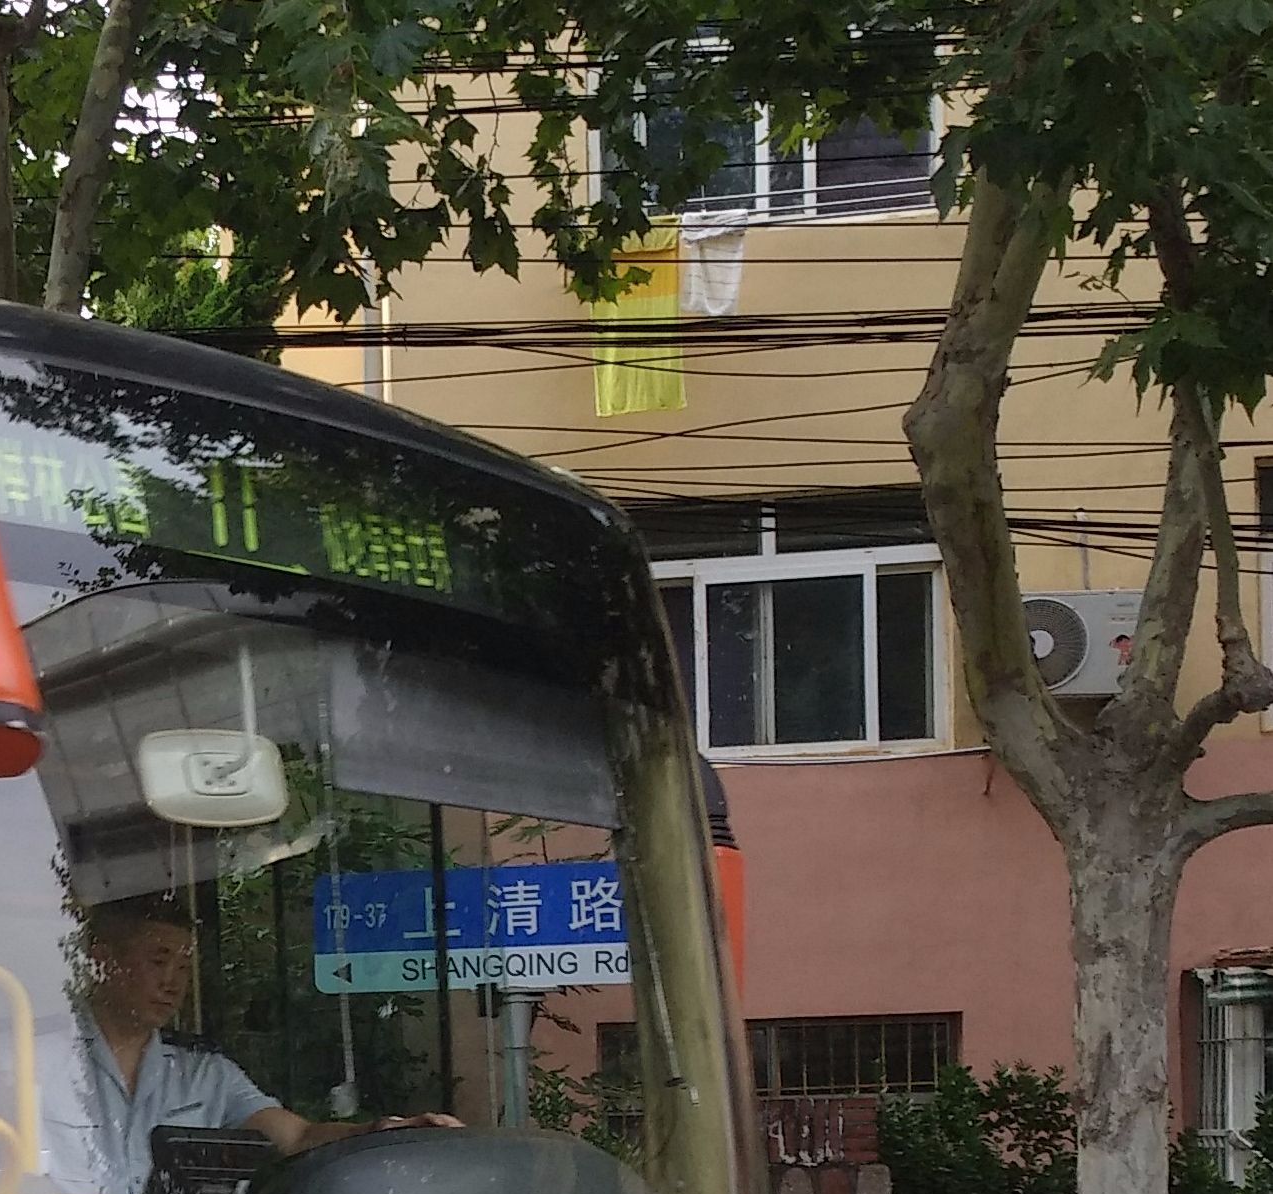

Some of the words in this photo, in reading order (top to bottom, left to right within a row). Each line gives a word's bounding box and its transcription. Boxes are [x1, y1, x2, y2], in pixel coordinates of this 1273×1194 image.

[209, 459, 260, 552] 11
[403, 876, 624, 939] 上清路
[402, 951, 579, 982] SHANGQING
[595, 949, 630, 974] Rd
